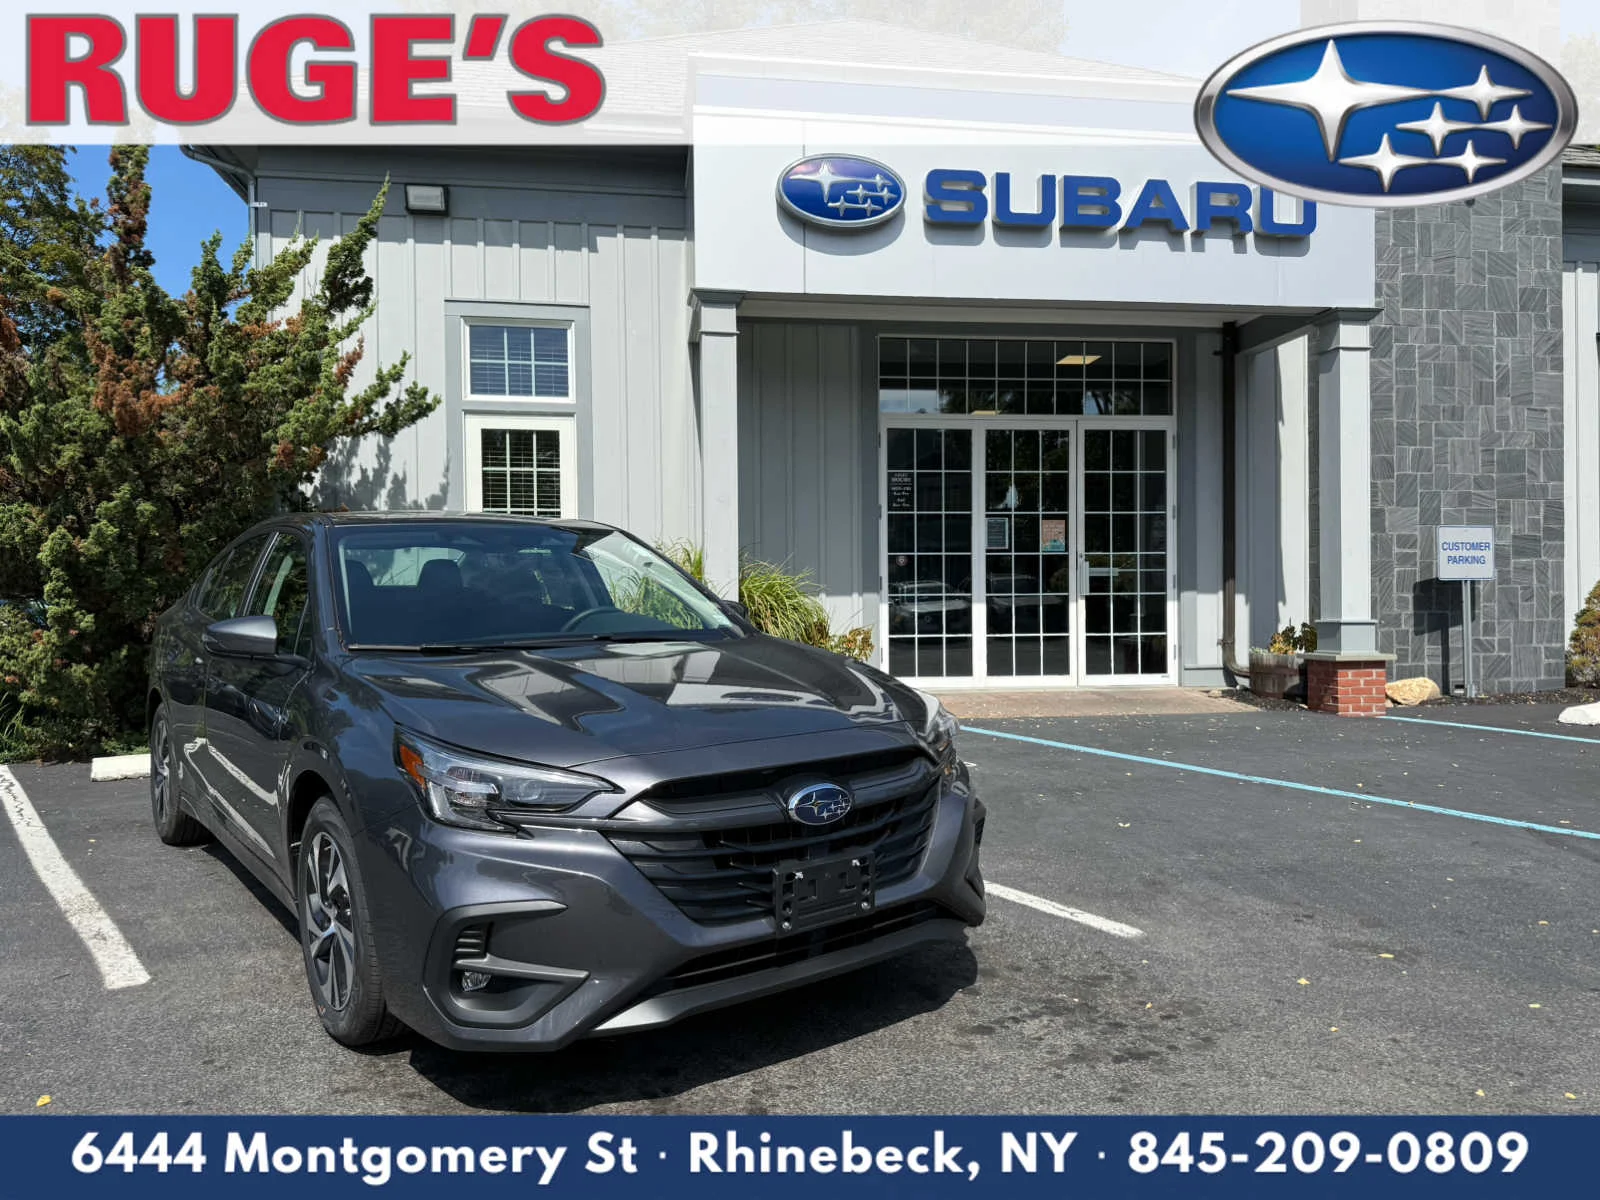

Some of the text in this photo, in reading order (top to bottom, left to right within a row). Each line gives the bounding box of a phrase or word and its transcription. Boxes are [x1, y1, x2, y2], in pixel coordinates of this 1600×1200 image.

[924, 168, 1317, 238] SUBARU
[1441, 541, 1491, 552] CUSTOMER
[1447, 555, 1486, 565] PARKING
